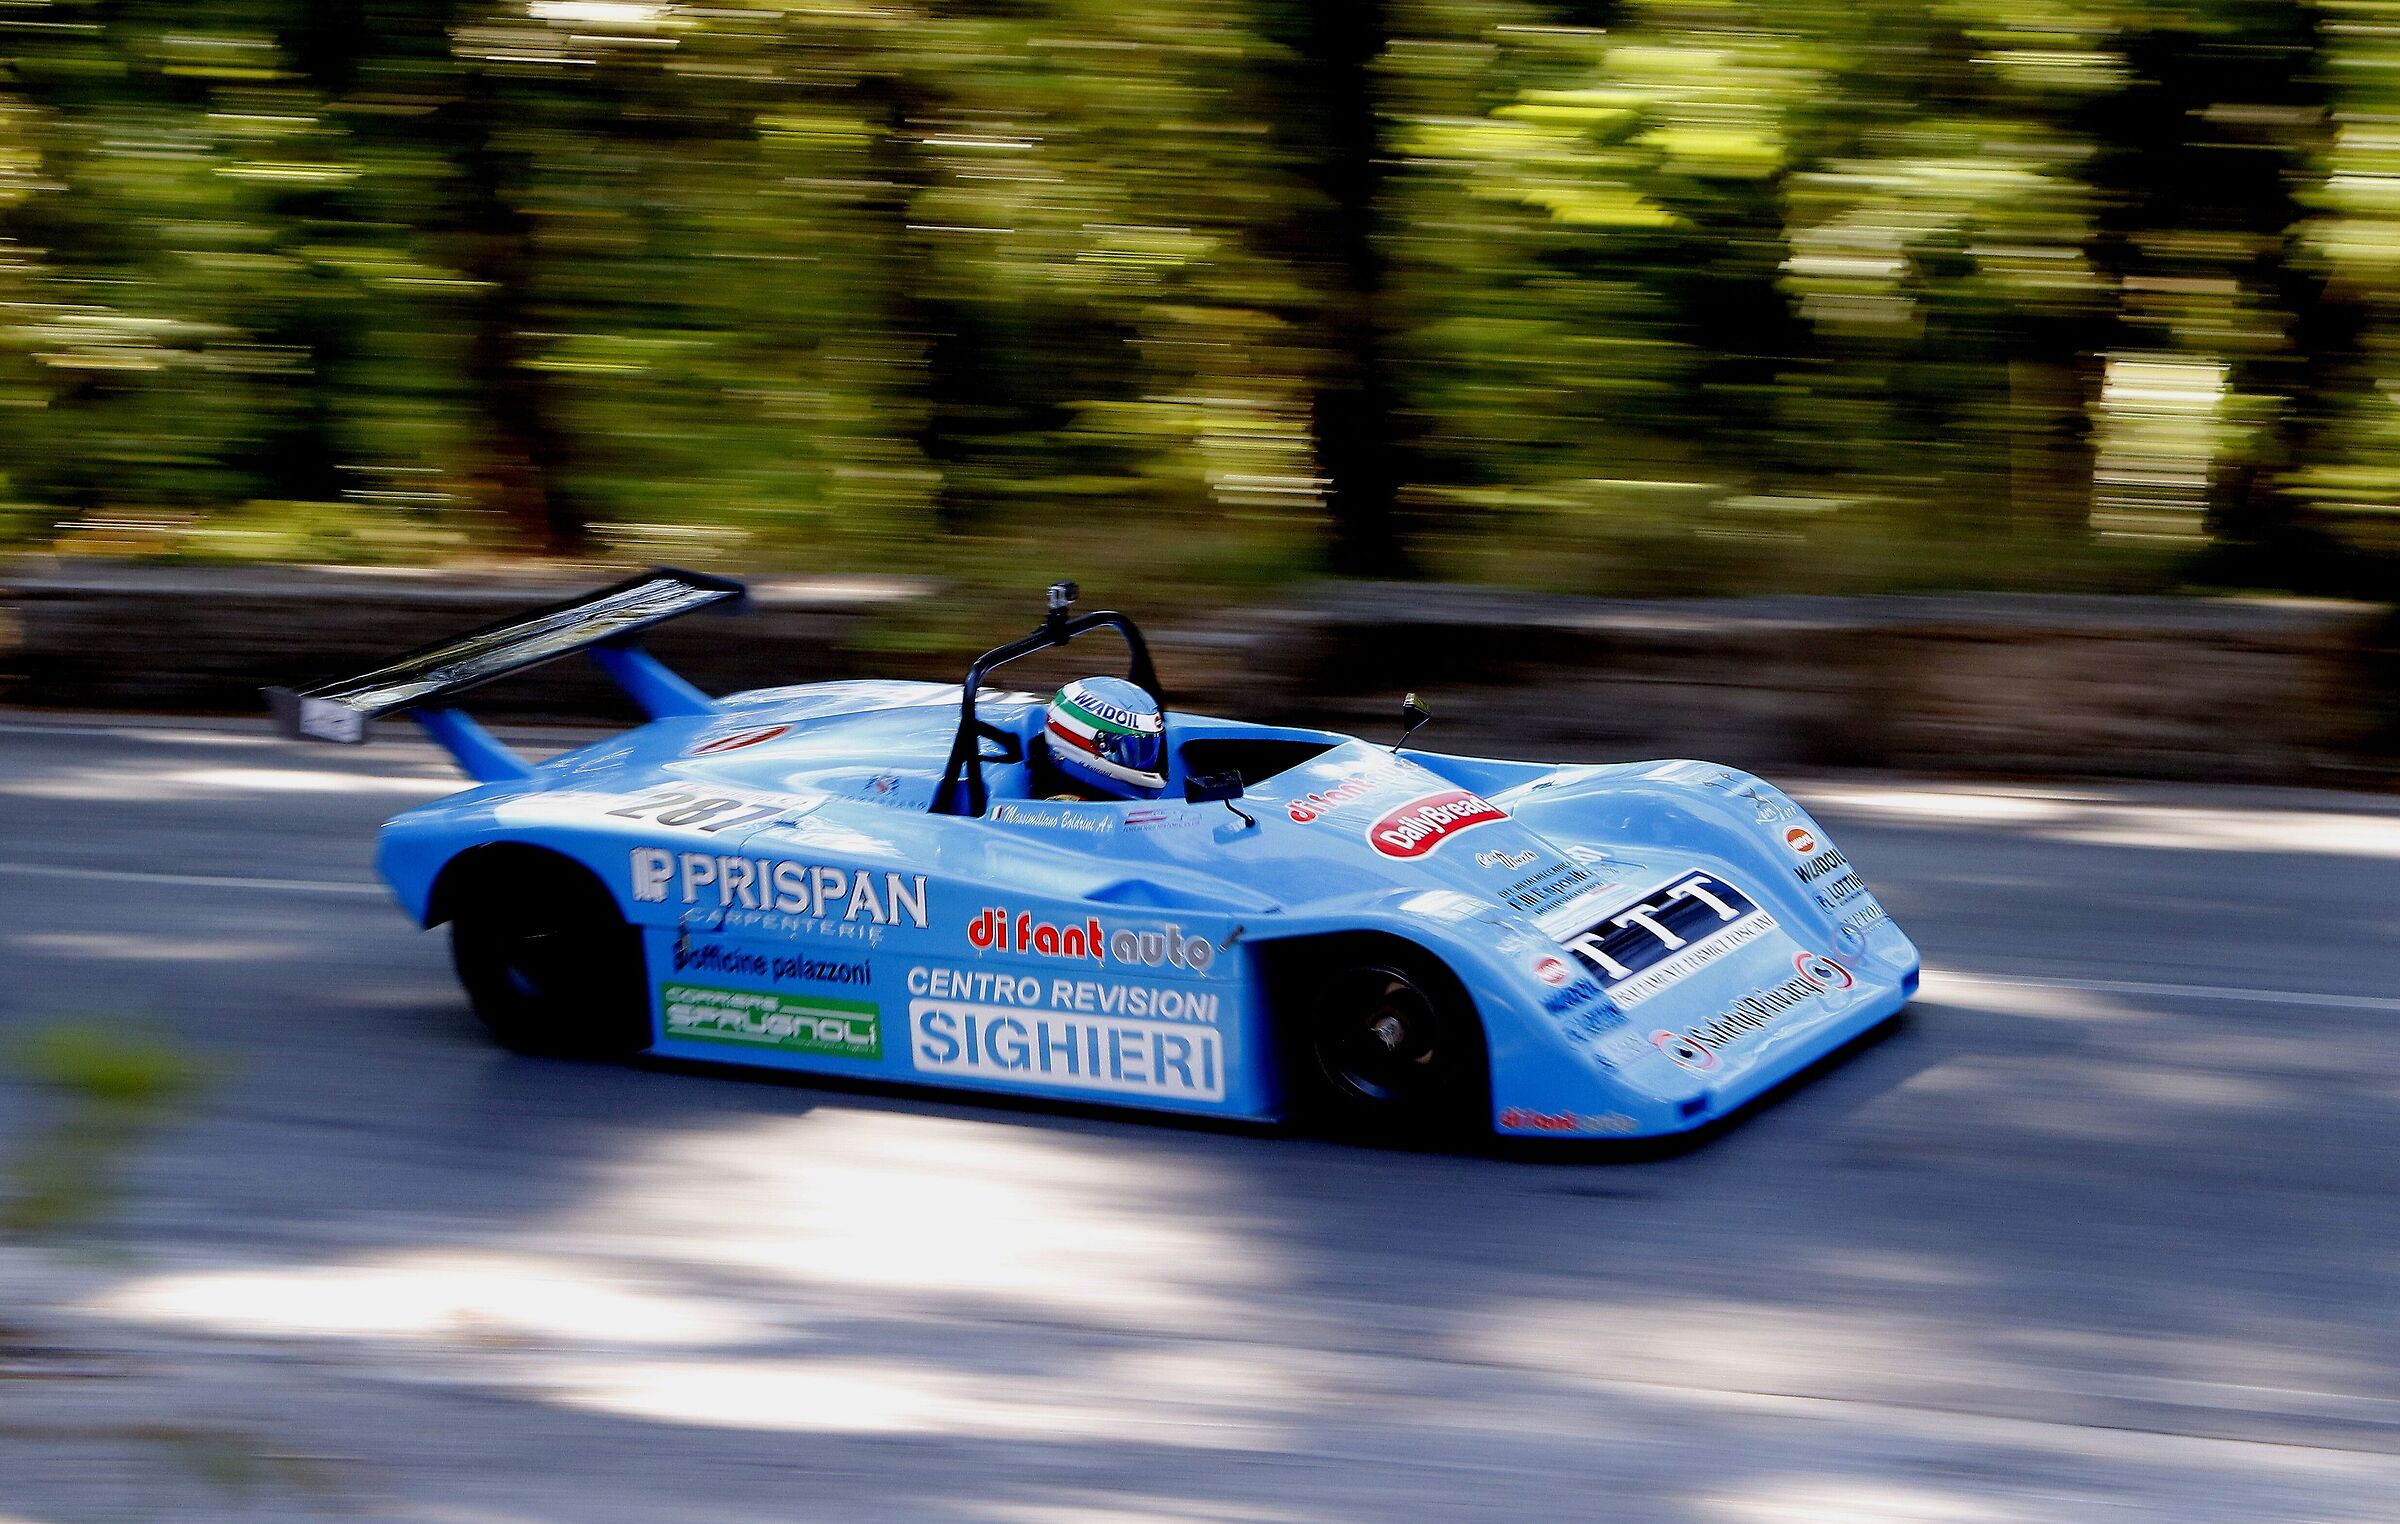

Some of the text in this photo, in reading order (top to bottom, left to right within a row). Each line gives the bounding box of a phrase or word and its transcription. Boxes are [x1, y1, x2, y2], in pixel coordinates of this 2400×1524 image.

[1074, 689, 1140, 730] WLADOIL
[604, 792, 786, 833] 287
[1003, 804, 1059, 828] Massimiliano
[1061, 809, 1096, 831] Boldrini
[1379, 795, 1496, 850] DailyBread
[679, 852, 929, 929] PRISPAN
[1792, 848, 1847, 884] WLADOIL
[680, 907, 884, 944] CARPENTERIE
[967, 907, 1215, 972] di fant auto
[1561, 875, 1740, 981] TTT
[1682, 939, 1730, 970] TERMICI
[1725, 914, 1775, 946] TOSCANI
[687, 944, 872, 986] officine palazzoni
[907, 966, 1219, 1023] CENTRO REVISIONI
[1686, 975, 1827, 1050] Safety&Privacy
[918, 1008, 1216, 1091] SIGHIERI
